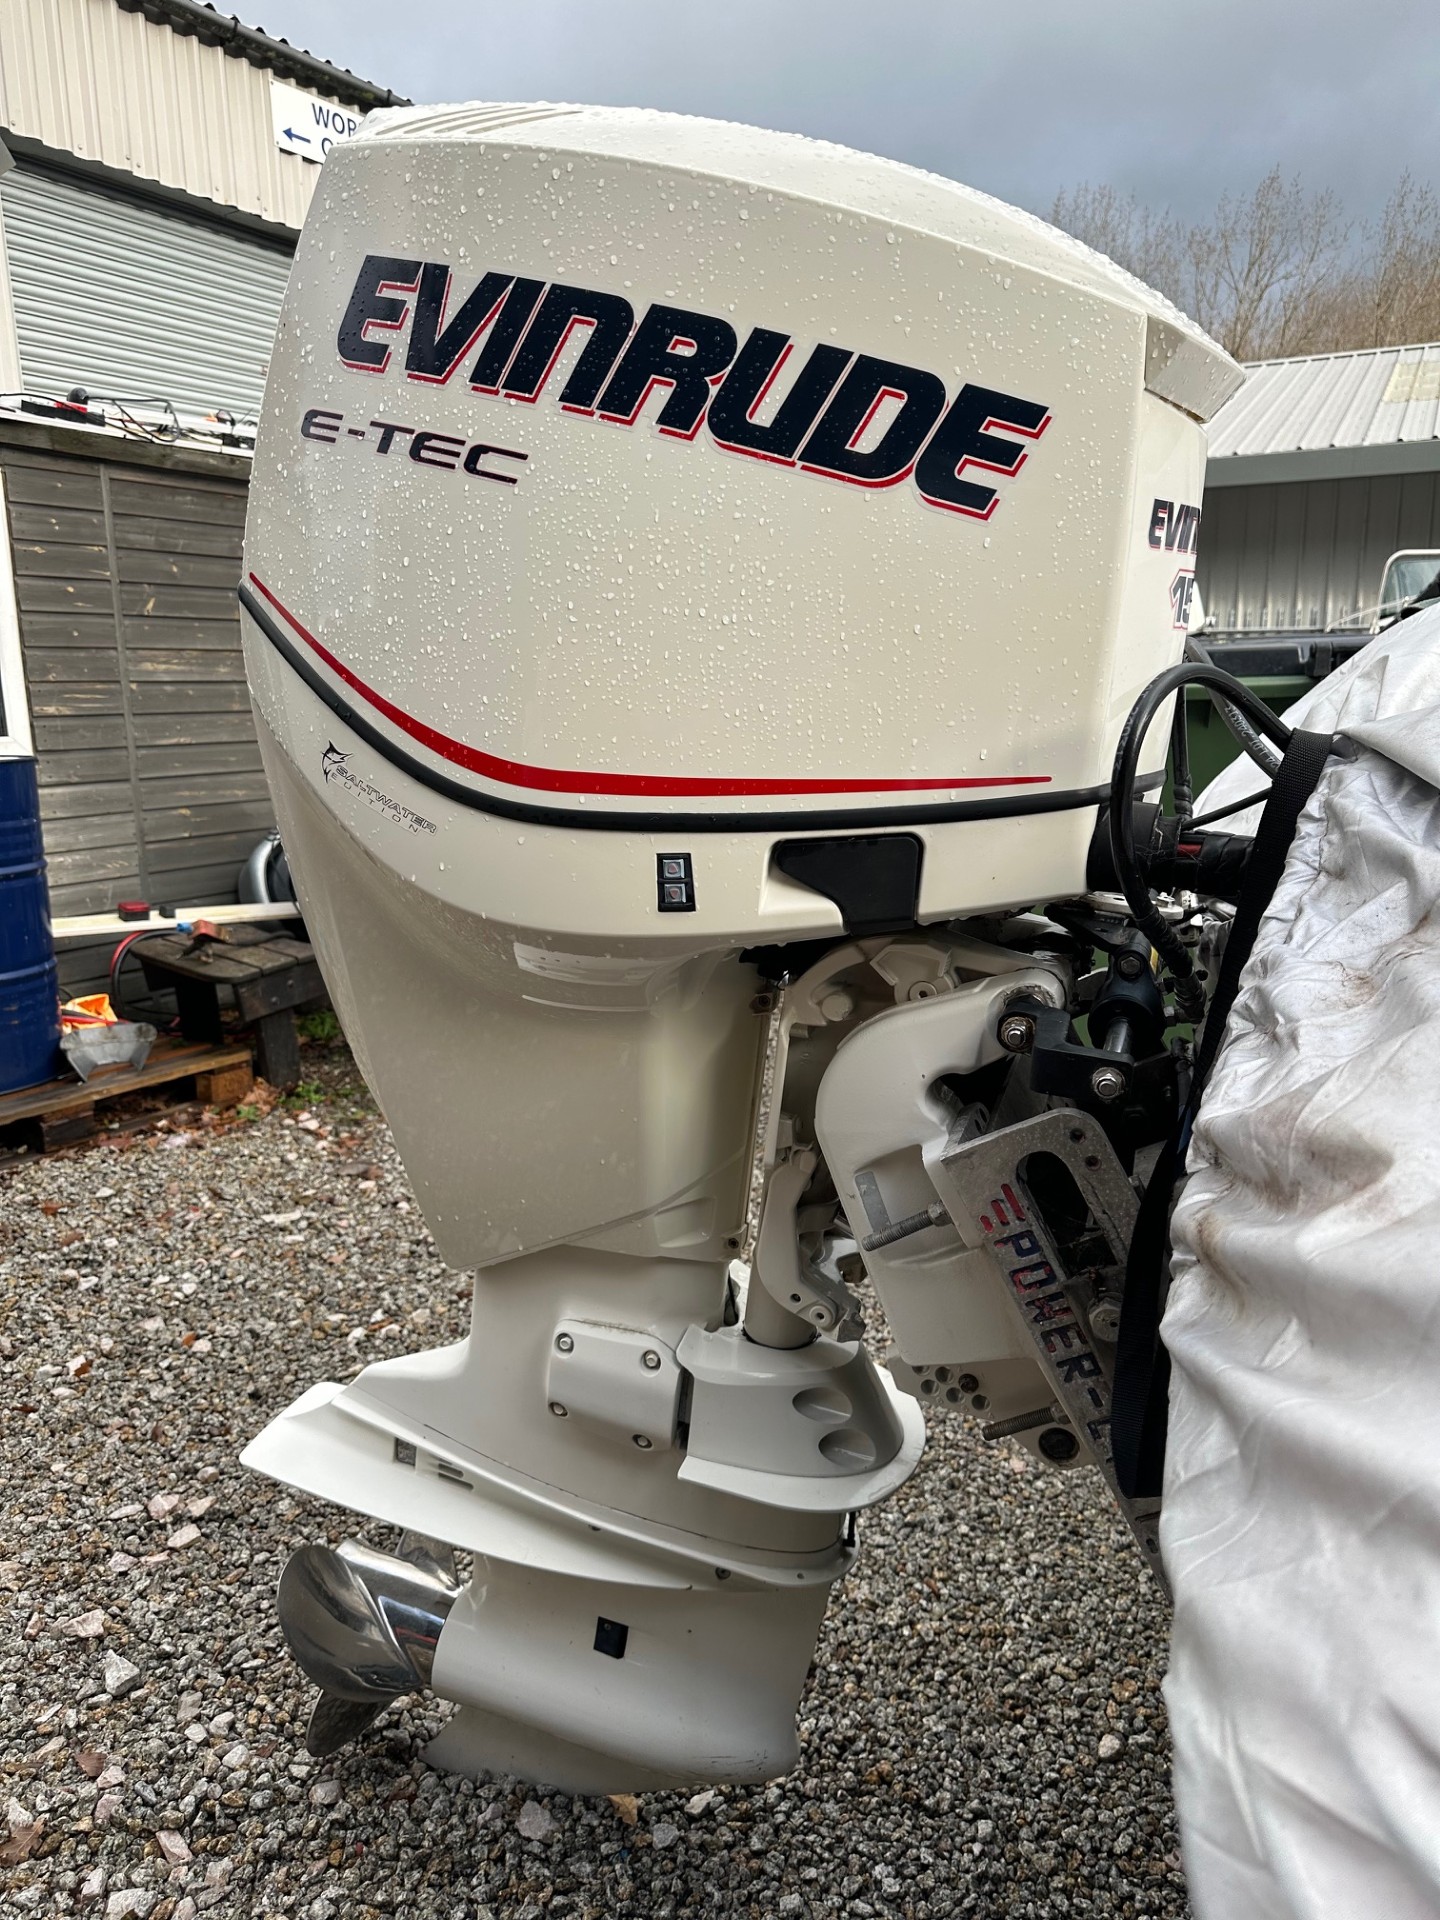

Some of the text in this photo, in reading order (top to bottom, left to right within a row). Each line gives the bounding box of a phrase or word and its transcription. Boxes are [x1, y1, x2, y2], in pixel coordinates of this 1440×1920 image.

[337, 254, 1053, 521] EVINRUDE
[301, 408, 529, 485] E-TEC
[331, 771, 418, 833] EDITION
[335, 764, 437, 834] SALTWATER
